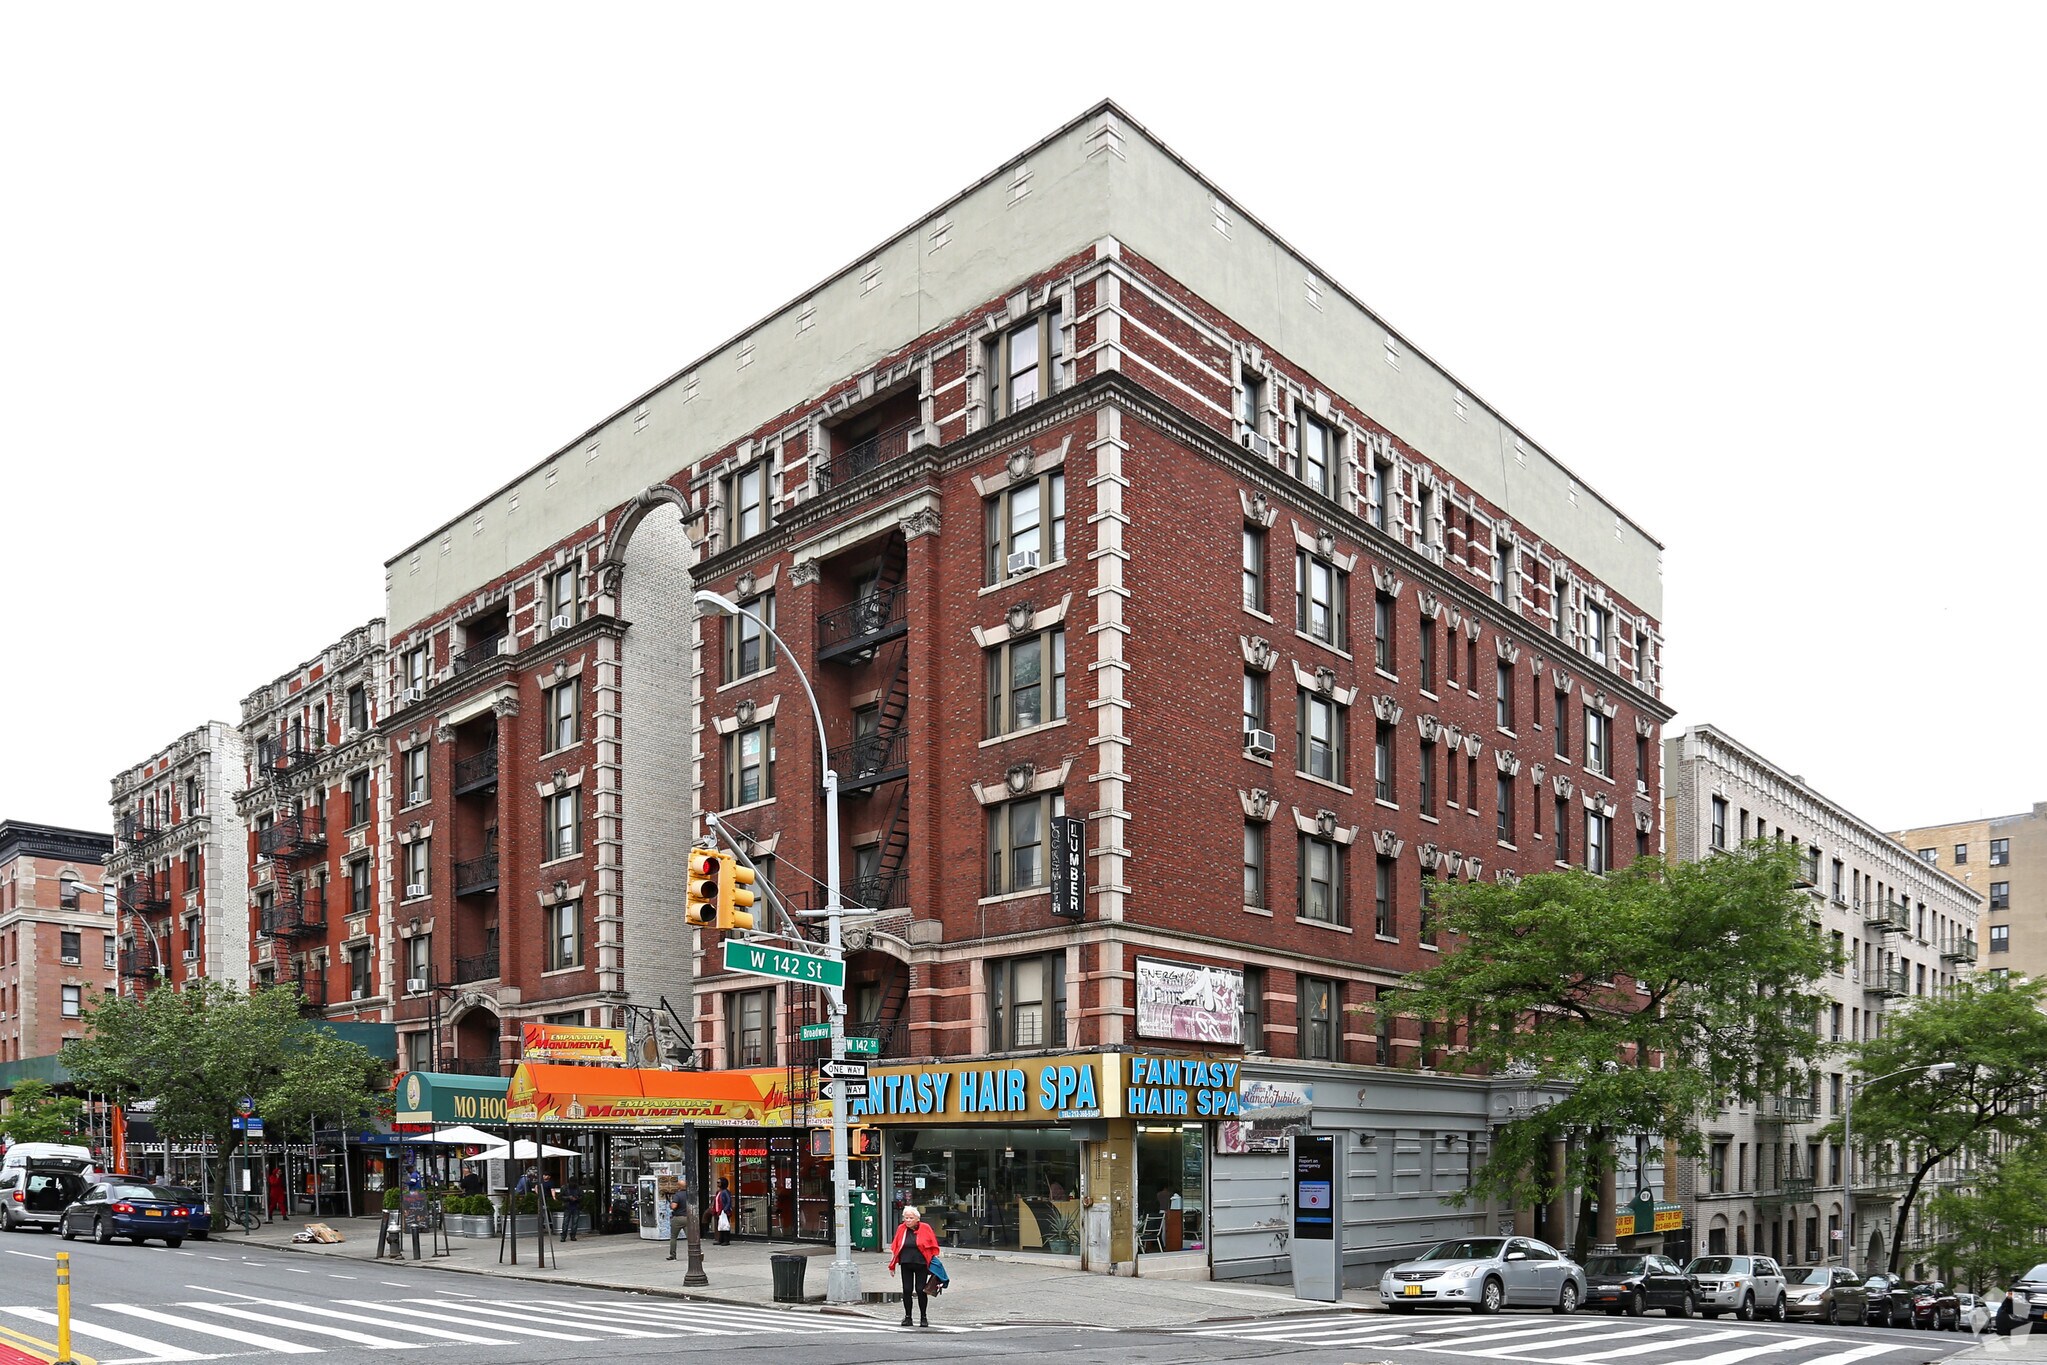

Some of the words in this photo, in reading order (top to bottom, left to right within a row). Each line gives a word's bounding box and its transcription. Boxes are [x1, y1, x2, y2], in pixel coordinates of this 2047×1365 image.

[750, 950, 766, 969] W
[773, 955, 800, 975] 142
[807, 962, 822, 979] St
[550, 1033, 604, 1041] EMPANADAS
[803, 1026, 829, 1039] Broadway
[846, 1039, 853, 1050] W
[856, 1040, 868, 1051] 142
[828, 1065, 844, 1073] ONE
[847, 1066, 862, 1074] WAY
[1132, 1057, 1239, 1088] FANTASY
[846, 1086, 863, 1094] WAY
[960, 1069, 1026, 1113] HAIR
[1040, 1065, 1097, 1111] SPA
[1251, 1084, 1266, 1093] Gran
[616, 1100, 712, 1108] EMPANADAS
[1128, 1088, 1188, 1115] HAIR
[1197, 1089, 1240, 1115] SPA
[1243, 1090, 1273, 1104] Rancho
[1271, 1089, 1301, 1108] Jubilee
[454, 1096, 477, 1118] MO
